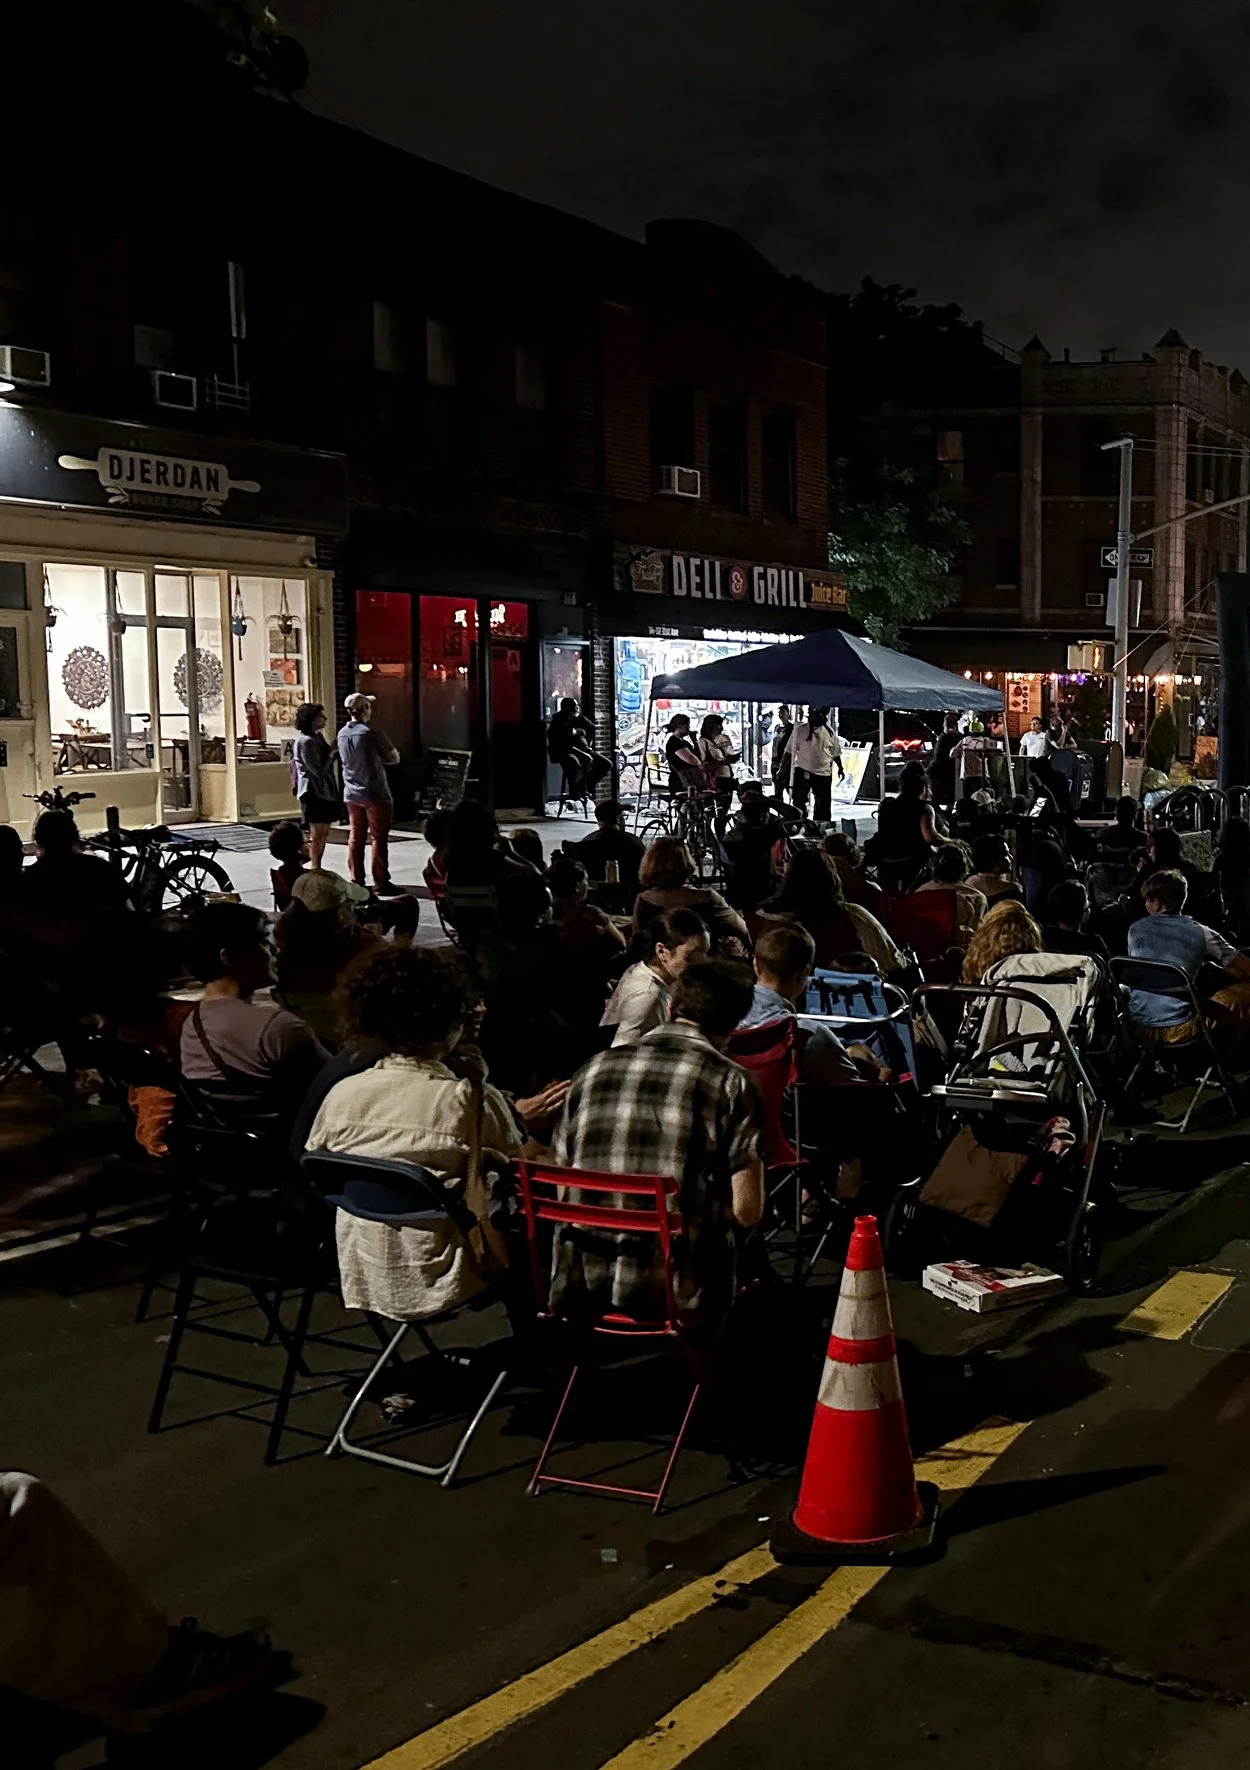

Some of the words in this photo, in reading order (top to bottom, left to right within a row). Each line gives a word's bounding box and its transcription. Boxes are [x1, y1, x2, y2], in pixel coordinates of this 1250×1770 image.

[109, 454, 220, 492] DJERDAN
[672, 554, 722, 600] DELI
[731, 570, 744, 595] &
[752, 565, 808, 609] GRILL
[284, 742, 295, 757] A
